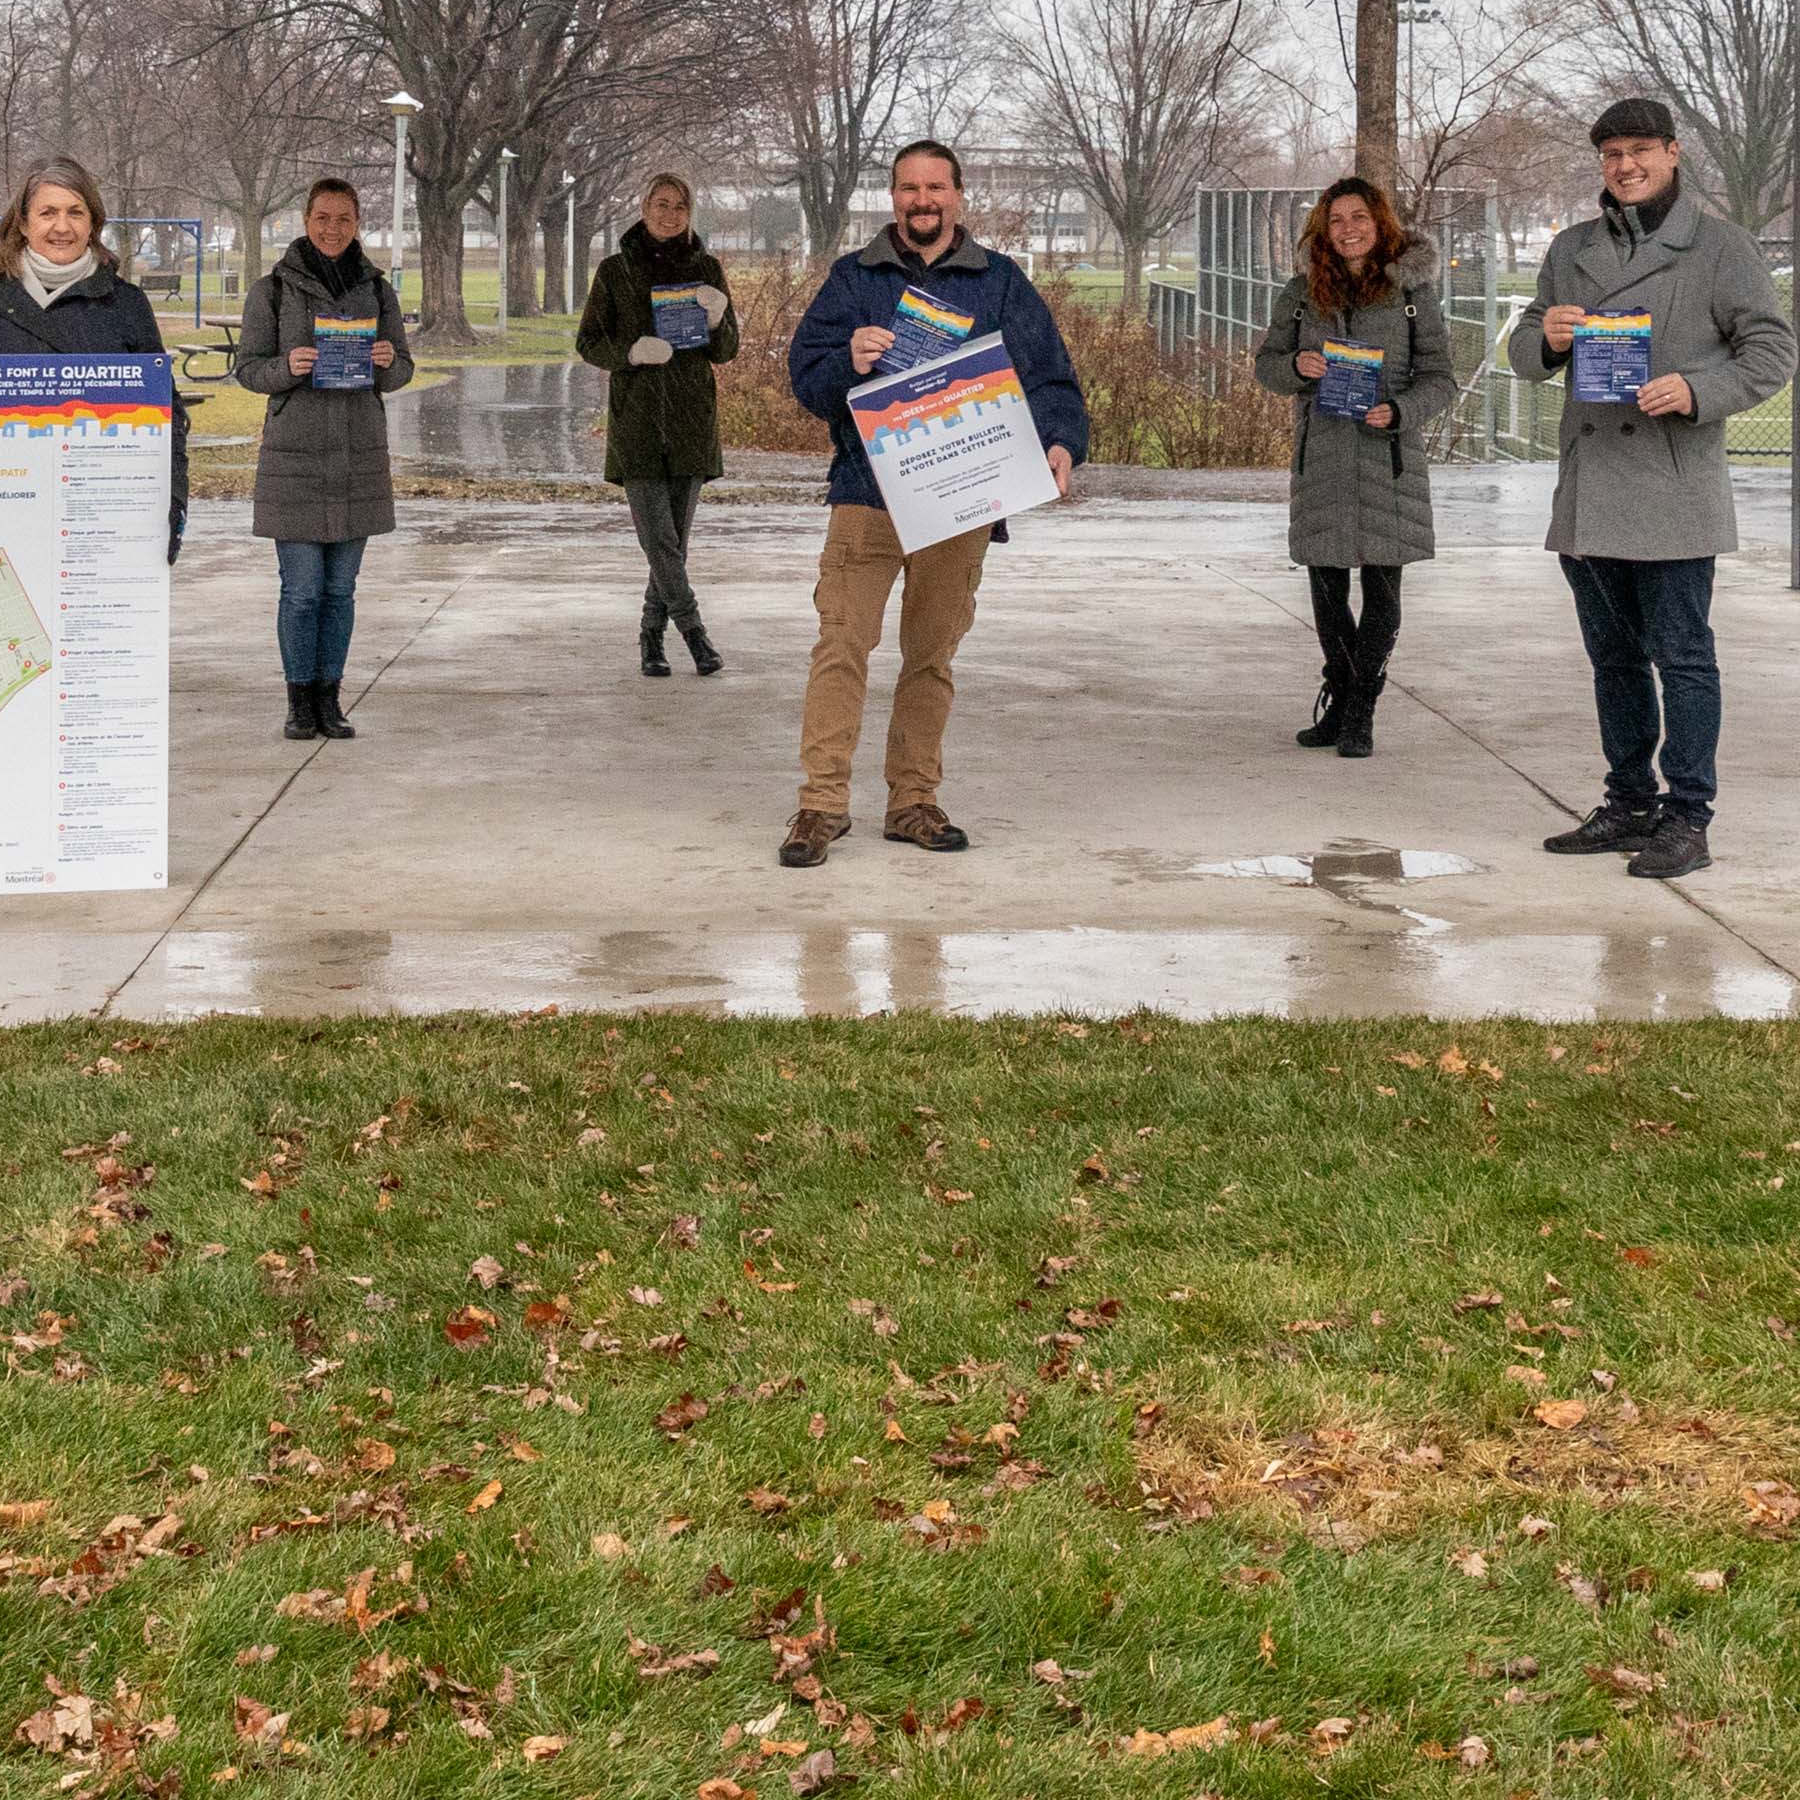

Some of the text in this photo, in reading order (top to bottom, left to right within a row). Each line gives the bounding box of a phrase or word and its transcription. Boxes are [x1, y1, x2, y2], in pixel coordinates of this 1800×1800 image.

[6, 367, 39, 378] FONT
[42, 367, 56, 378] LE
[61, 366, 143, 380] QUARTIER
[73, 380, 83, 388] 14
[84, 379, 122, 387] DÉCEMBRE
[902, 404, 925, 419] IDÉES
[943, 383, 985, 403] QUARTIER
[899, 423, 1006, 468] DÉPOSEZ VOTRE BULLETIN
[899, 467, 911, 477] DE
[912, 459, 935, 473] VOTE
[936, 449, 960, 464] DANS
[961, 439, 987, 455] CETTE
[954, 504, 992, 524] Montréal
[5, 874, 44, 885] Montréal
